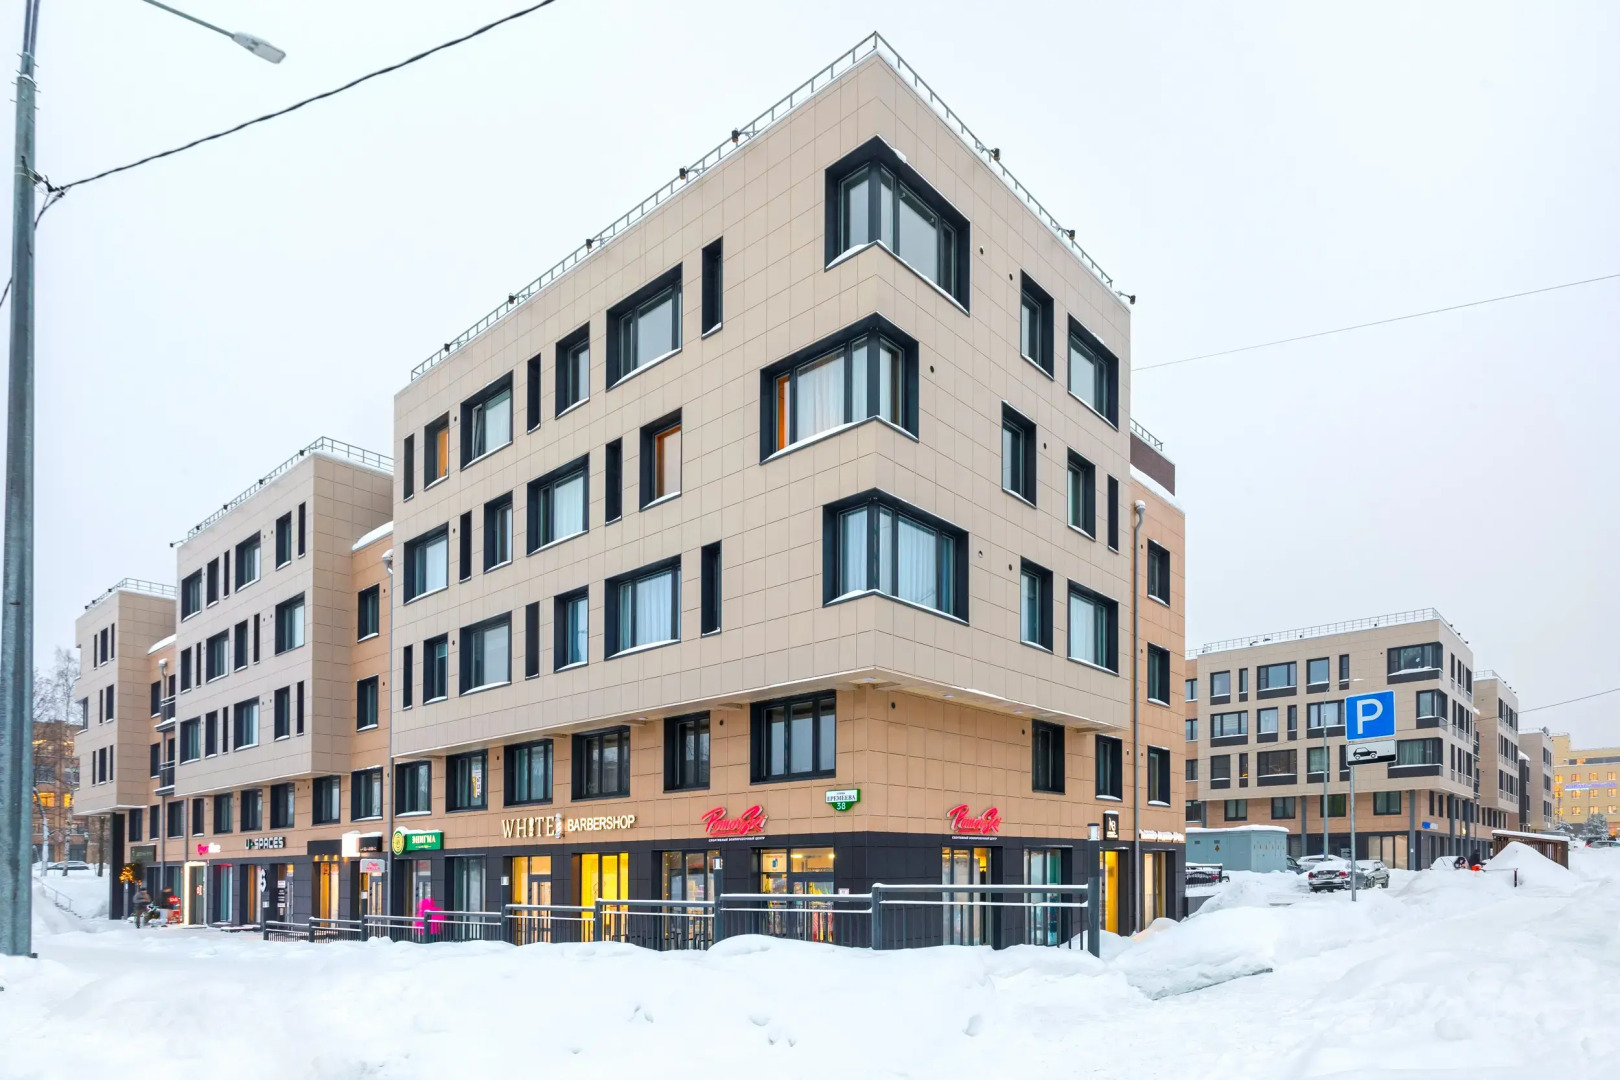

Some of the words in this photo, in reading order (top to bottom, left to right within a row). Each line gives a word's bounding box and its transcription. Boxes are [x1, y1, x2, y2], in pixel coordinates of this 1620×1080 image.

[1356, 698, 1383, 735] P
[836, 802, 846, 810] 38
[567, 814, 636, 832] BARBERSHOP
[411, 834, 436, 844] ЭНИГМА
